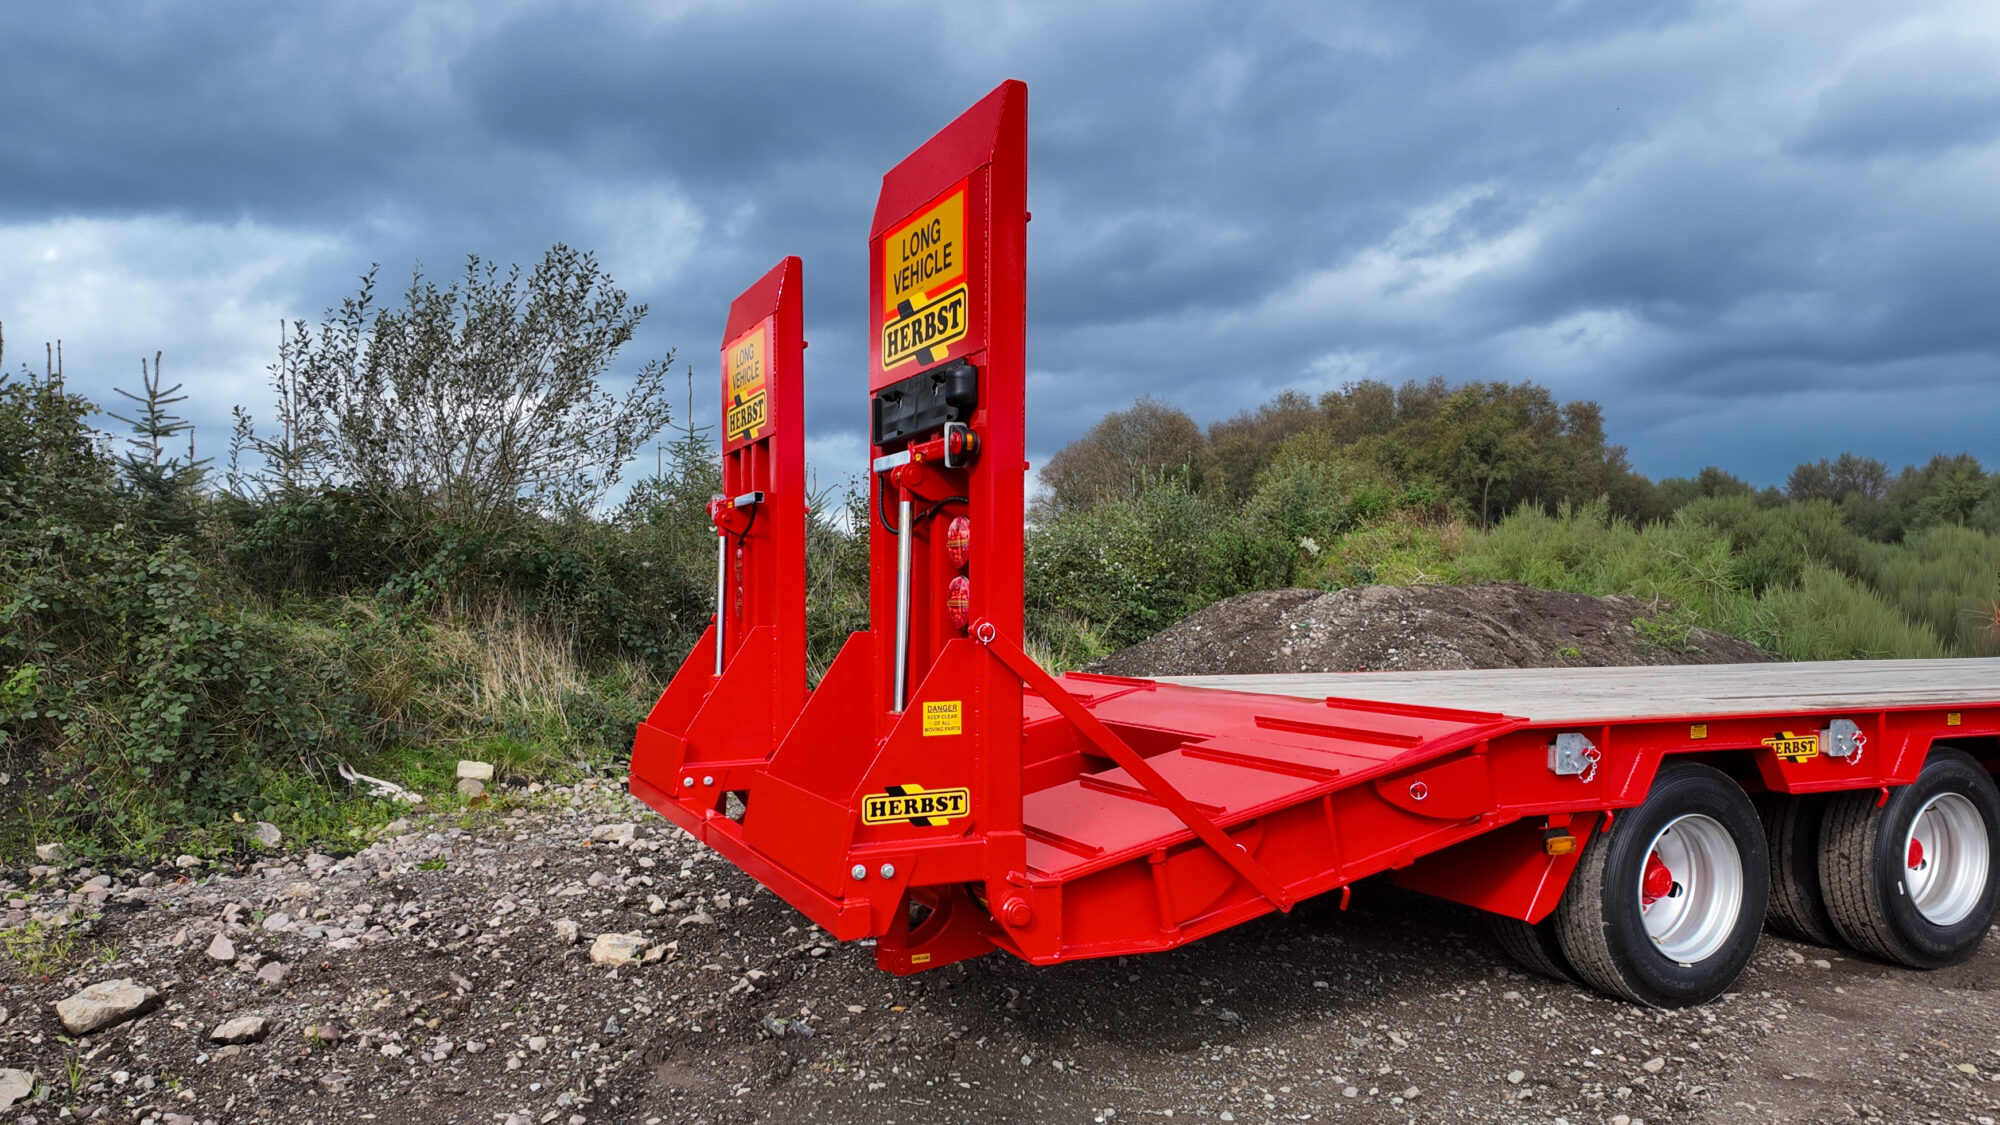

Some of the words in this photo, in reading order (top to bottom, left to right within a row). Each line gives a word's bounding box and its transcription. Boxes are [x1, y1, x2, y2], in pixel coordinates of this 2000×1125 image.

[902, 218, 941, 262] LONG
[893, 241, 953, 295] VEHICLE
[887, 298, 962, 358] HERBST
[736, 343, 754, 369] LONG
[732, 360, 759, 390] VEHICLE
[729, 399, 764, 433] HERBST
[927, 704, 957, 713] DANGER
[1769, 741, 1815, 754] ERBST
[870, 795, 963, 817] HERBST
